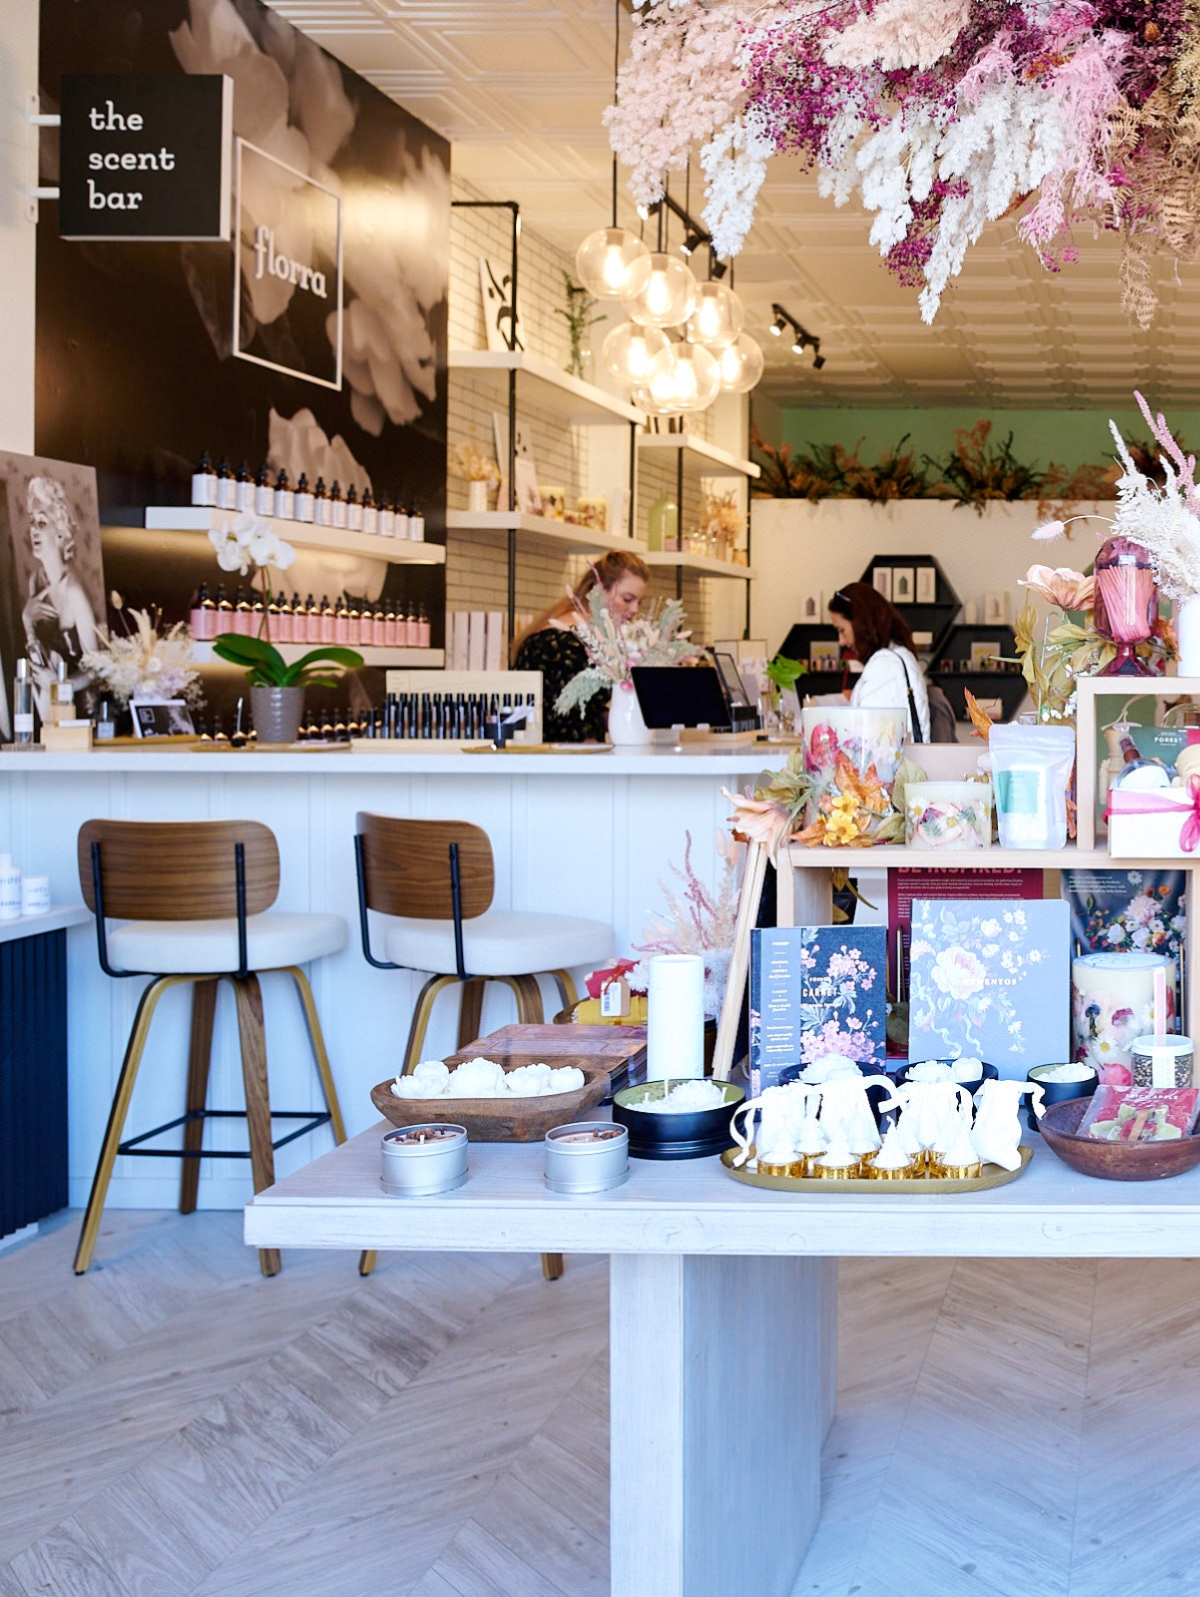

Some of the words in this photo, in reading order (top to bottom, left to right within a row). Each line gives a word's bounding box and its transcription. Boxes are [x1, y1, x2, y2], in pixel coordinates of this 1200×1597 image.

[89, 100, 144, 131] the
[88, 147, 176, 171] scent
[86, 179, 144, 210] bar
[254, 225, 328, 299] florra
[802, 987, 838, 997] CARNET
